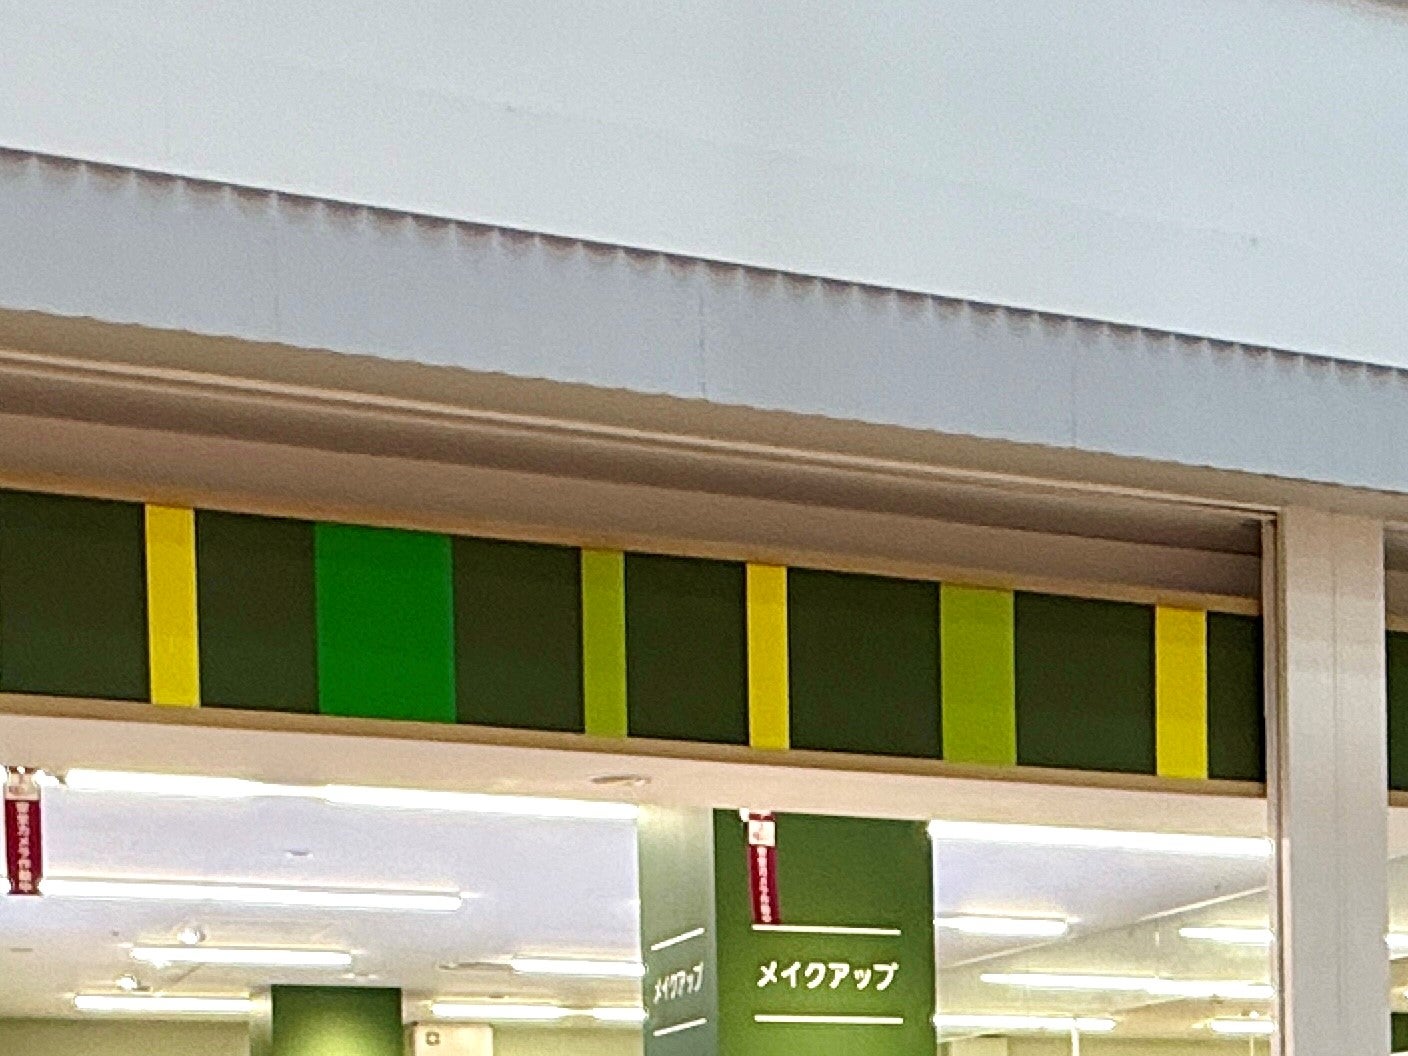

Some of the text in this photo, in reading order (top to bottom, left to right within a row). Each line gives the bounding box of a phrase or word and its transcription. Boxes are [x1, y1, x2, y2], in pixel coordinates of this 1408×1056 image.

[653, 961, 704, 1003] メイクアップ
[756, 960, 899, 991] メイクアップ
